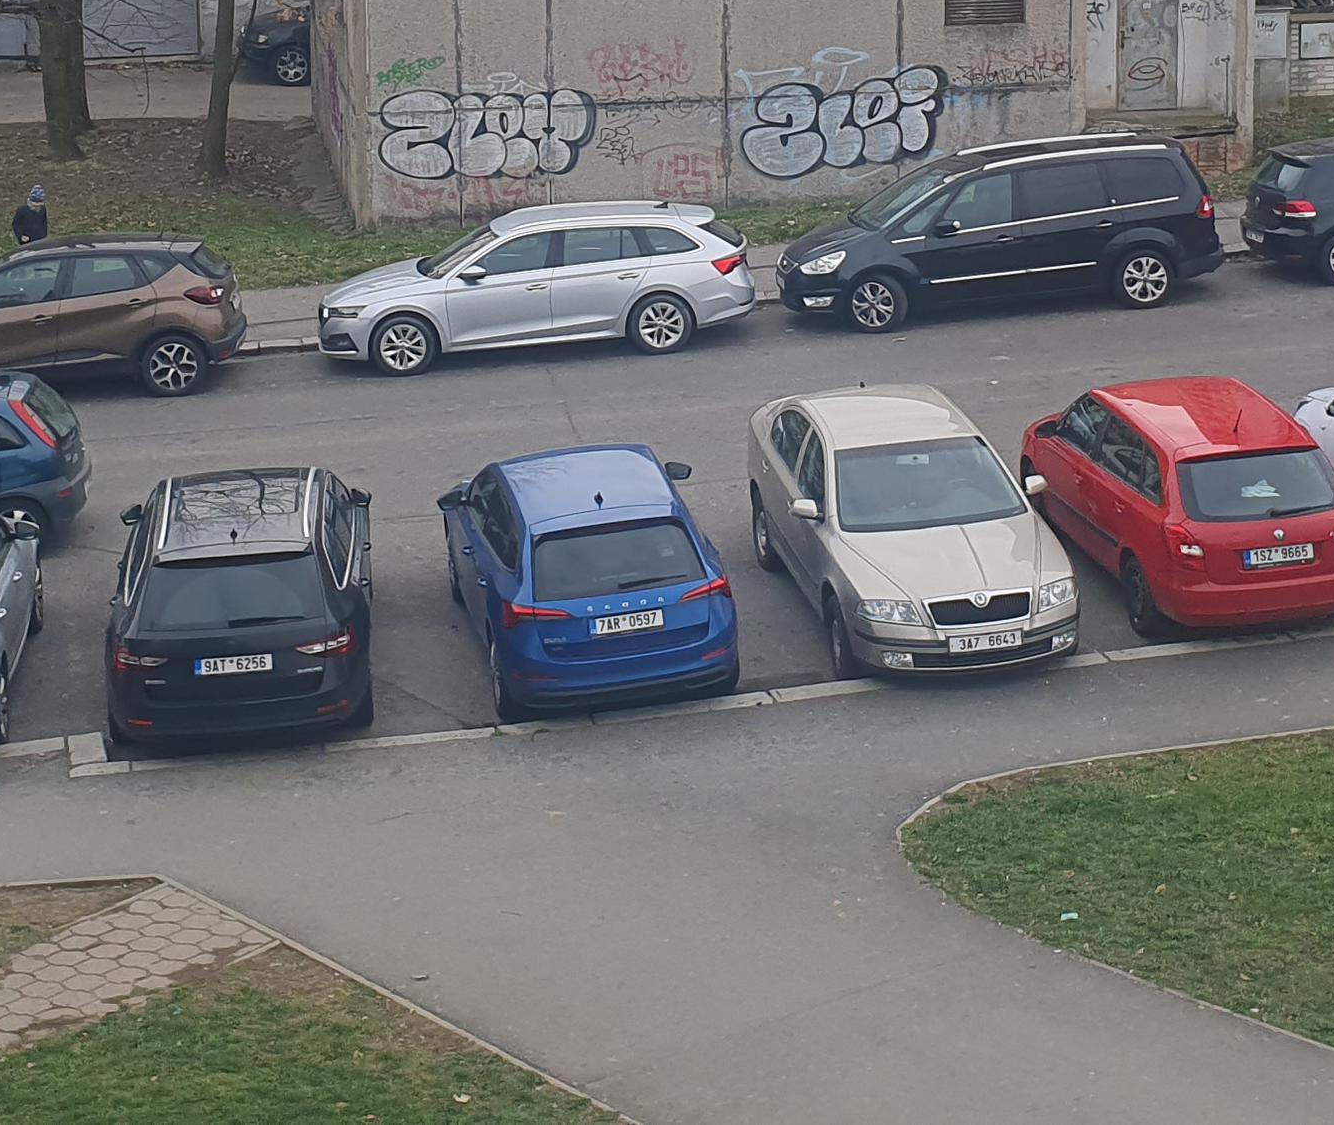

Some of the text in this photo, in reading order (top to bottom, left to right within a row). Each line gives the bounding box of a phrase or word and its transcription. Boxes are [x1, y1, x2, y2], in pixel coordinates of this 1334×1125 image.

[1253, 545, 1309, 563] 1SZ 9665
[598, 612, 657, 632] 7AR 0597
[958, 633, 1017, 651] 3A7 6643
[204, 656, 267, 673] 9AT 6256
